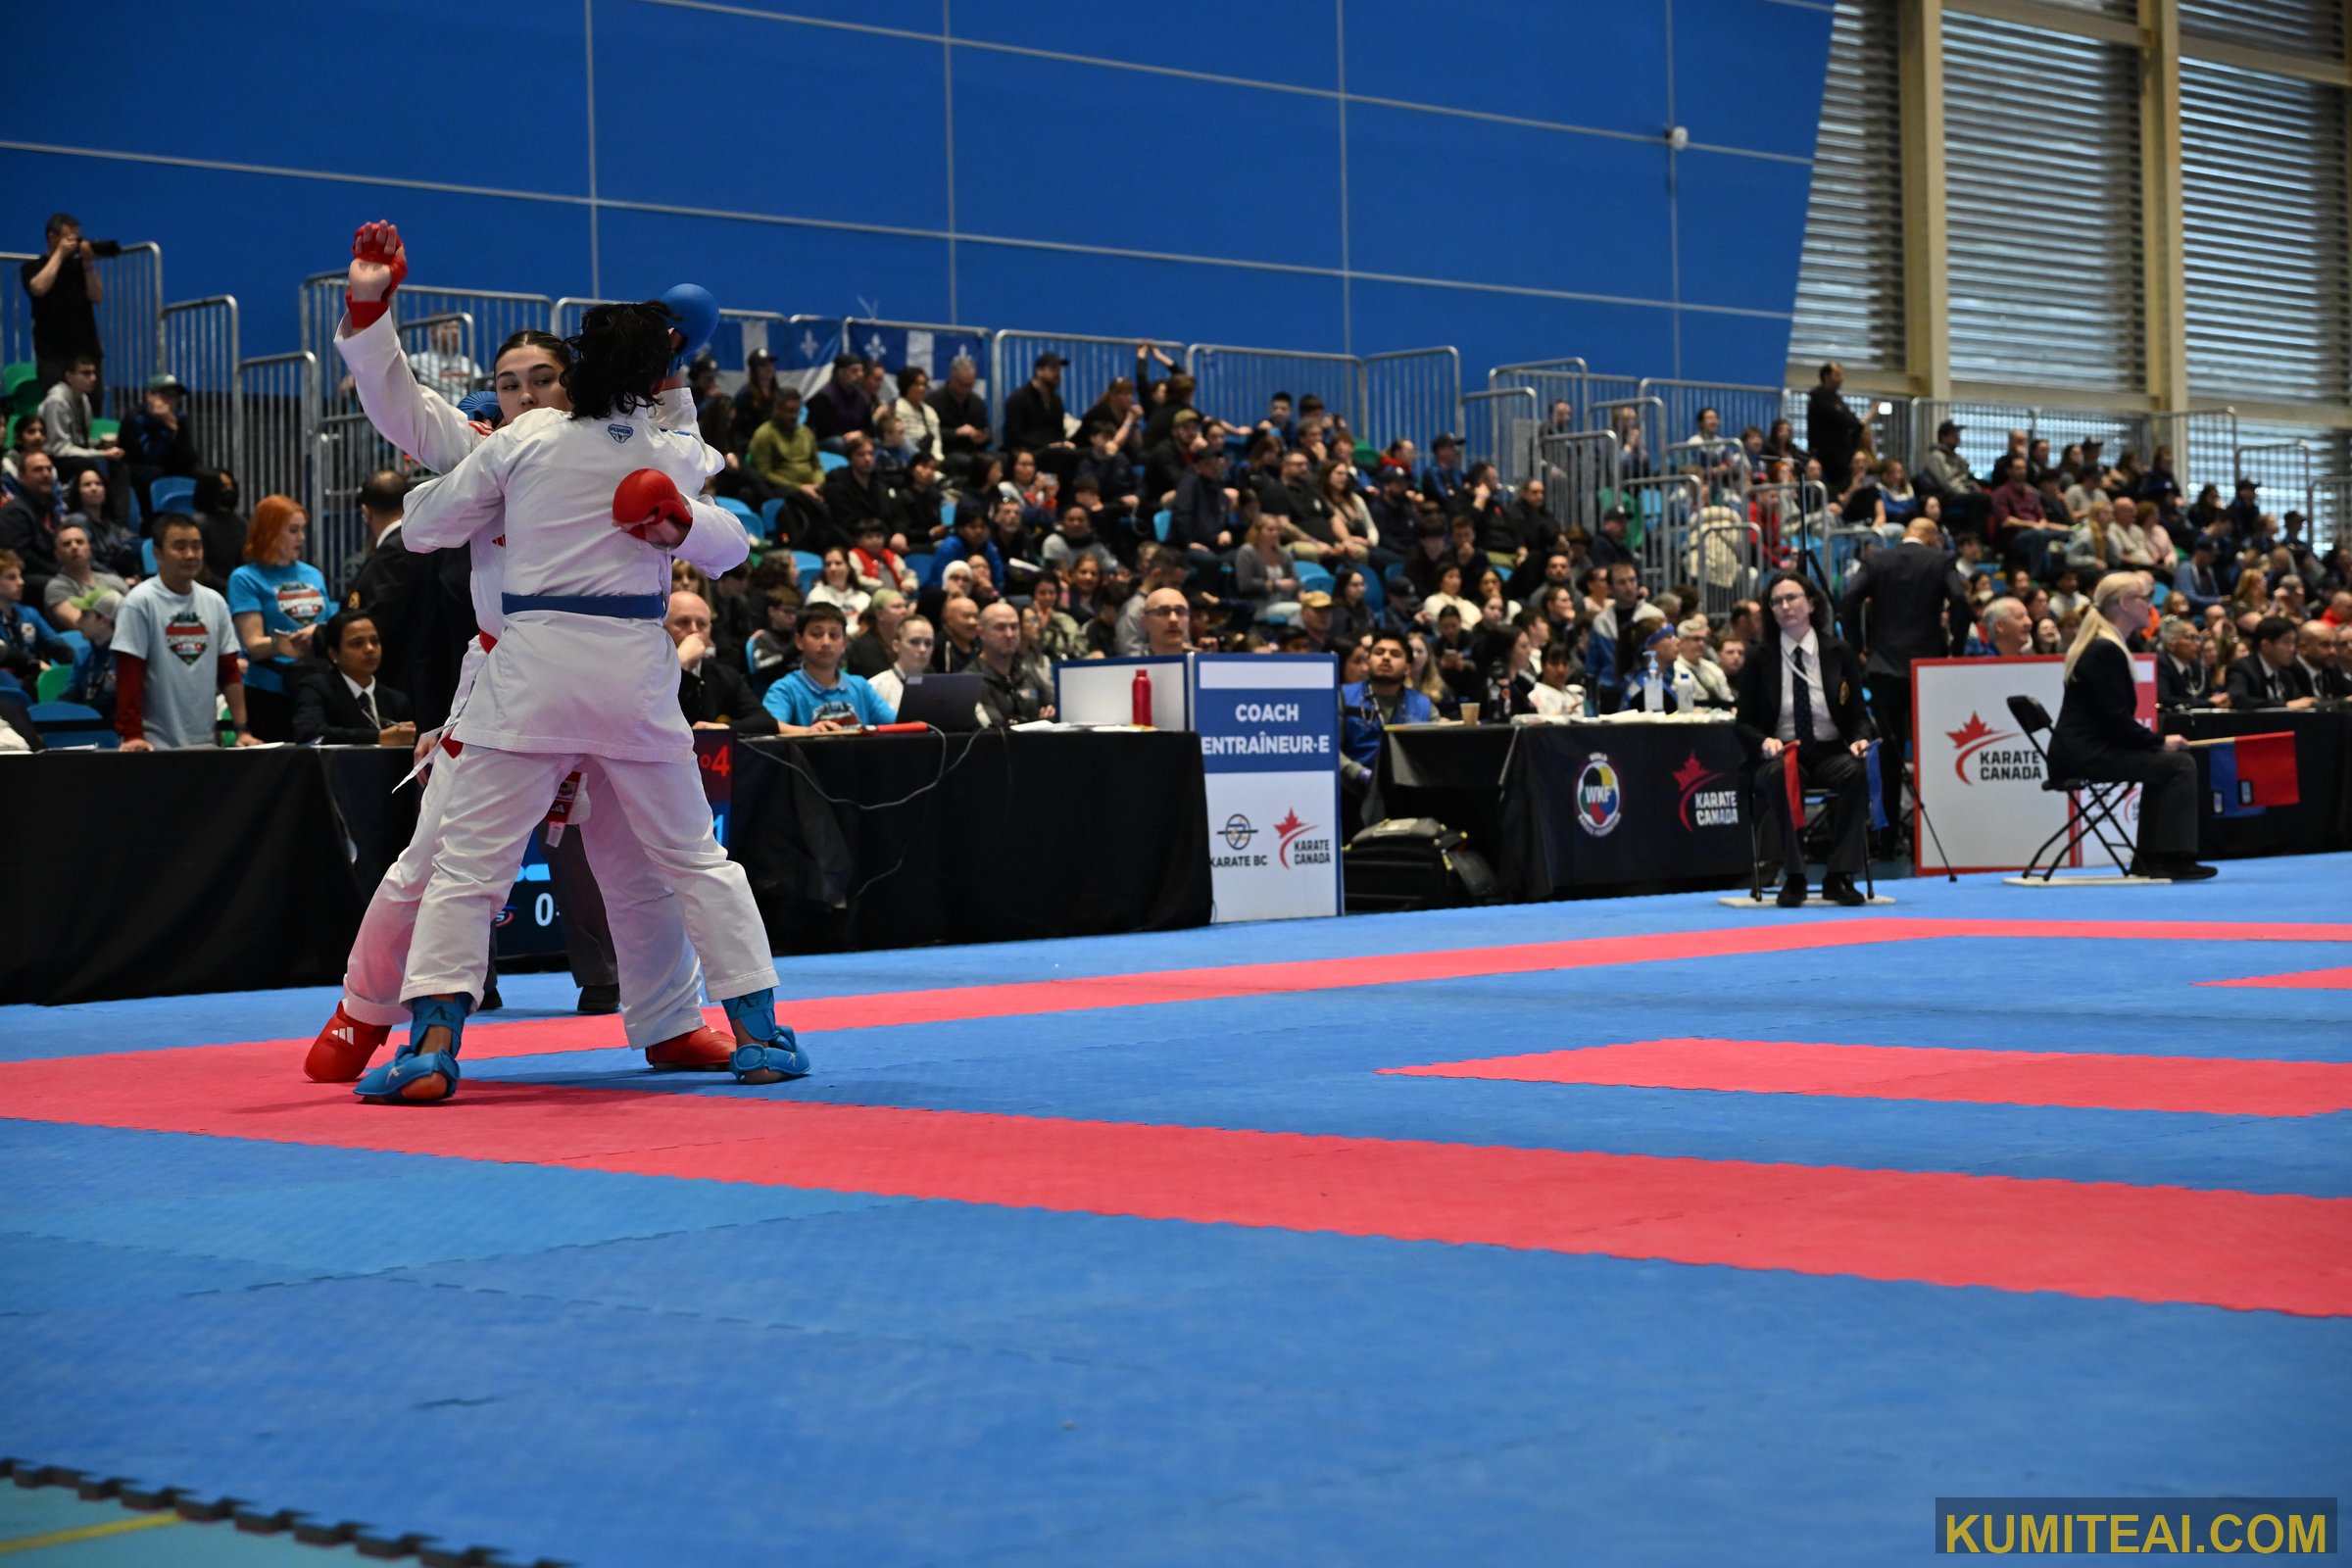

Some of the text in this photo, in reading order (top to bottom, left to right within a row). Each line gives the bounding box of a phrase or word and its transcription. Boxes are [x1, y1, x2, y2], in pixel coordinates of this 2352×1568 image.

[1236, 704, 1298, 722] COACH
[1980, 751, 2040, 764] KARATE
[1981, 766, 2042, 780] CANADA
[1585, 786, 1611, 804] WKF
[1694, 791, 1737, 808] KARATE
[1696, 808, 1739, 826] CANADA
[1294, 839, 1330, 852] KARATE
[1253, 855, 1267, 866] BC
[1295, 853, 1331, 864] CANADA
